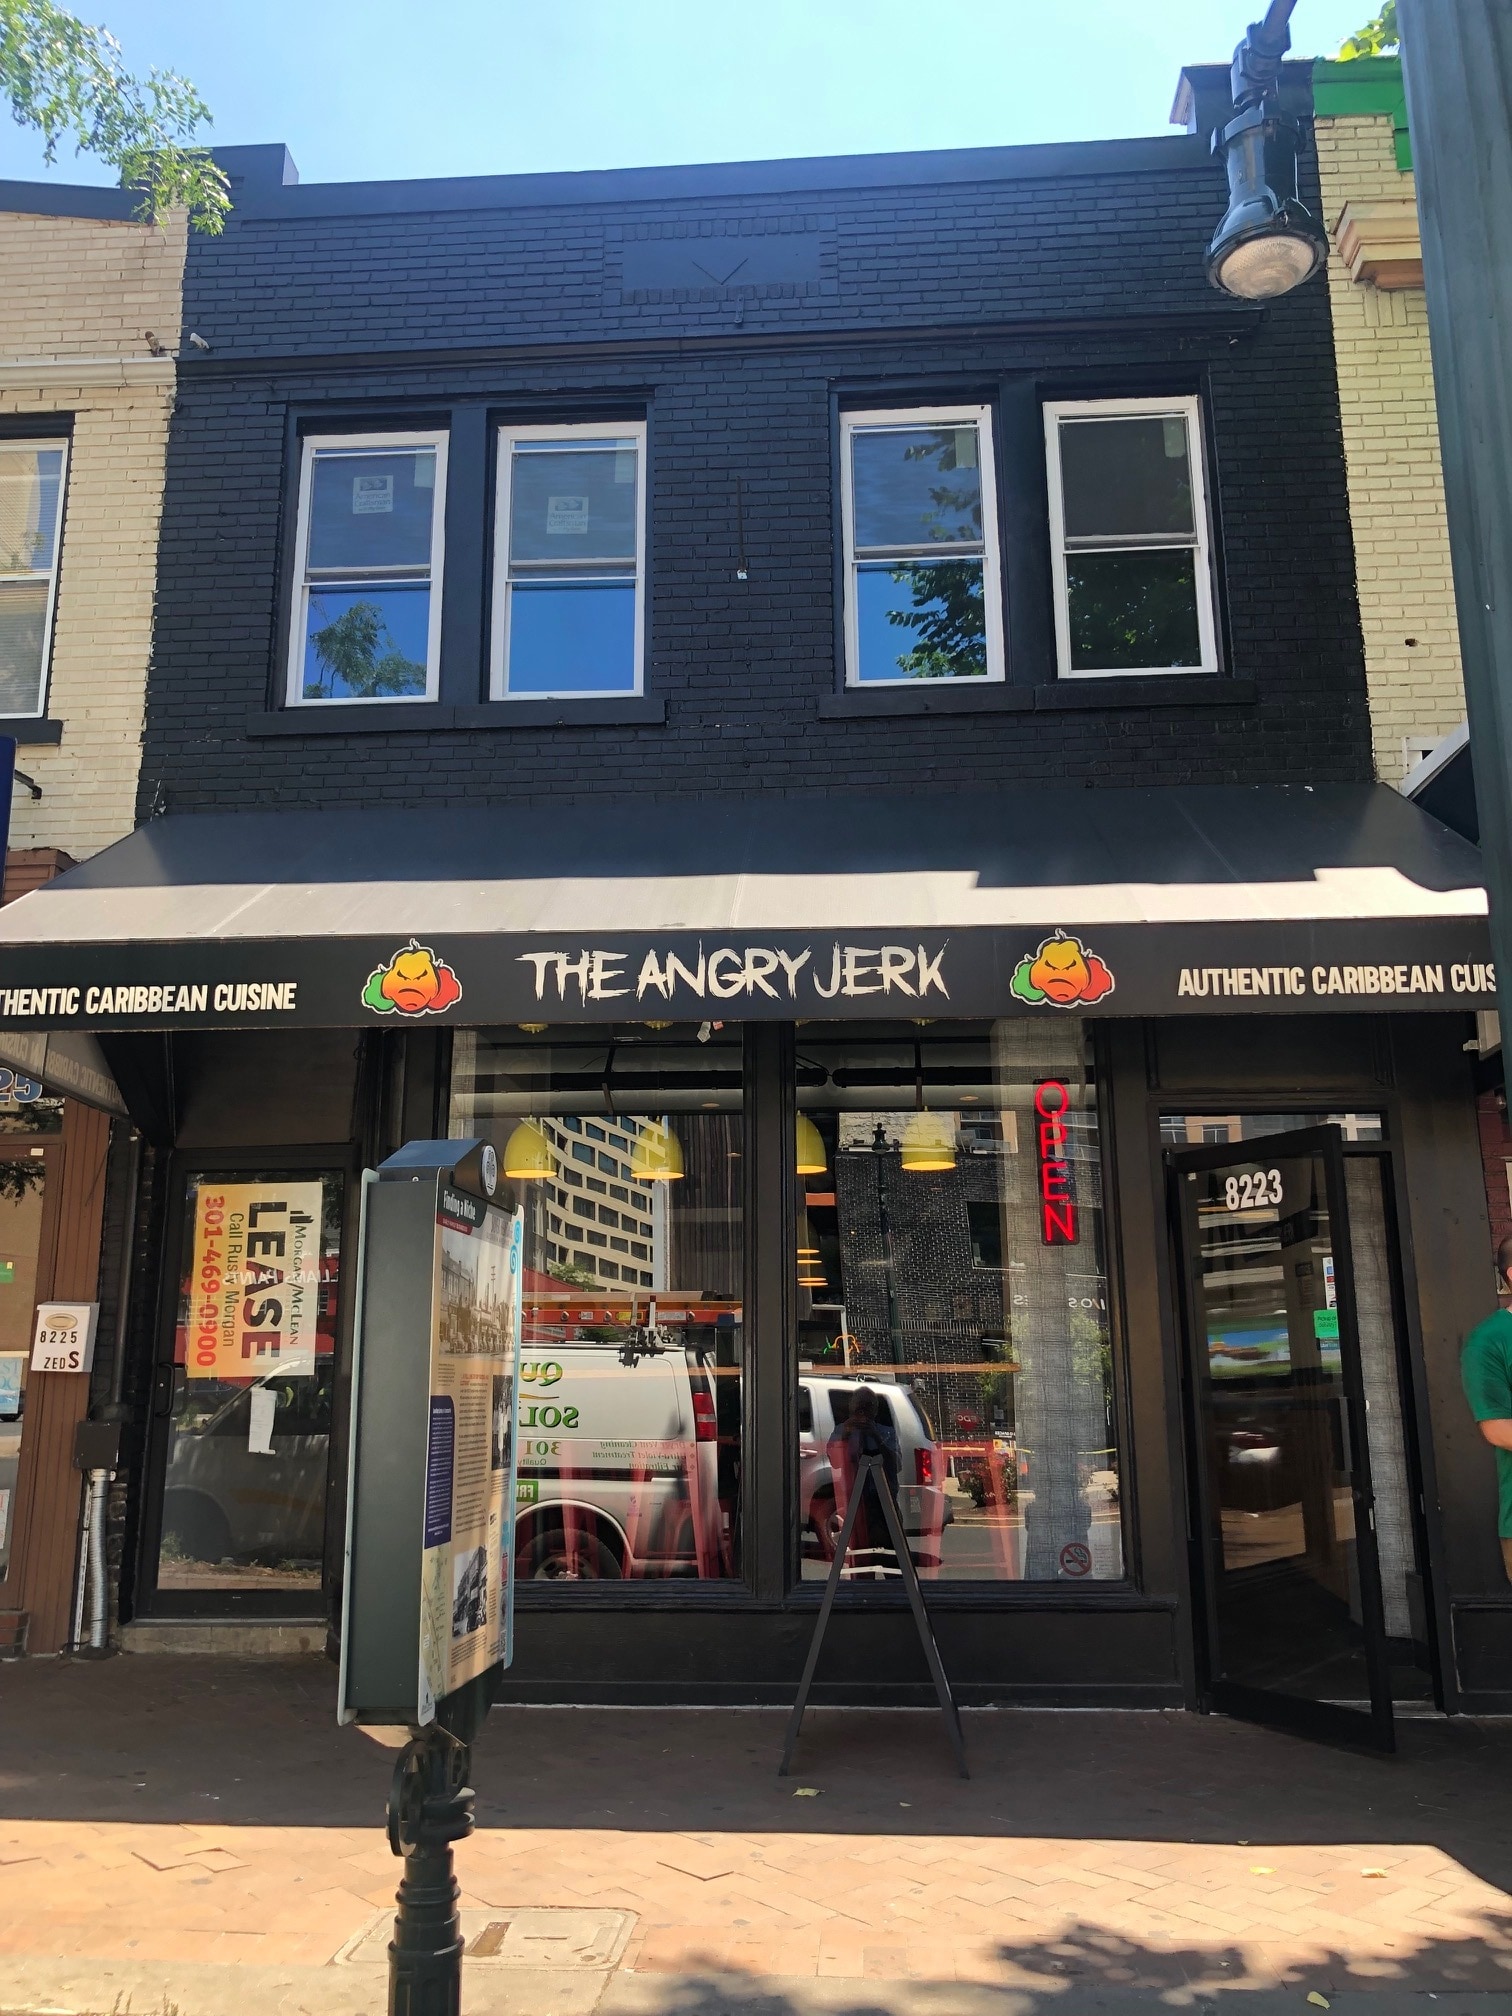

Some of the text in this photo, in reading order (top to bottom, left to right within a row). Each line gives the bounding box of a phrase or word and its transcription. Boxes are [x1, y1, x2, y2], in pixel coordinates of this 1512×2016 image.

[85, 984, 208, 1015] CARIBBEAN
[214, 983, 297, 1012] CUISINE
[514, 938, 950, 1008] THE ANGRY JERK
[1178, 966, 1306, 996] AUTHENTIC
[1311, 964, 1445, 995] CARIBBEAN
[1035, 1081, 1074, 1241] OPEN
[1225, 1168, 1283, 1211] 8223
[196, 1195, 225, 1367] 301-469-0900
[222, 1213, 245, 1347] Call Rusty Morgan
[241, 1201, 288, 1359] LEASE
[39, 1330, 78, 1344] 8225
